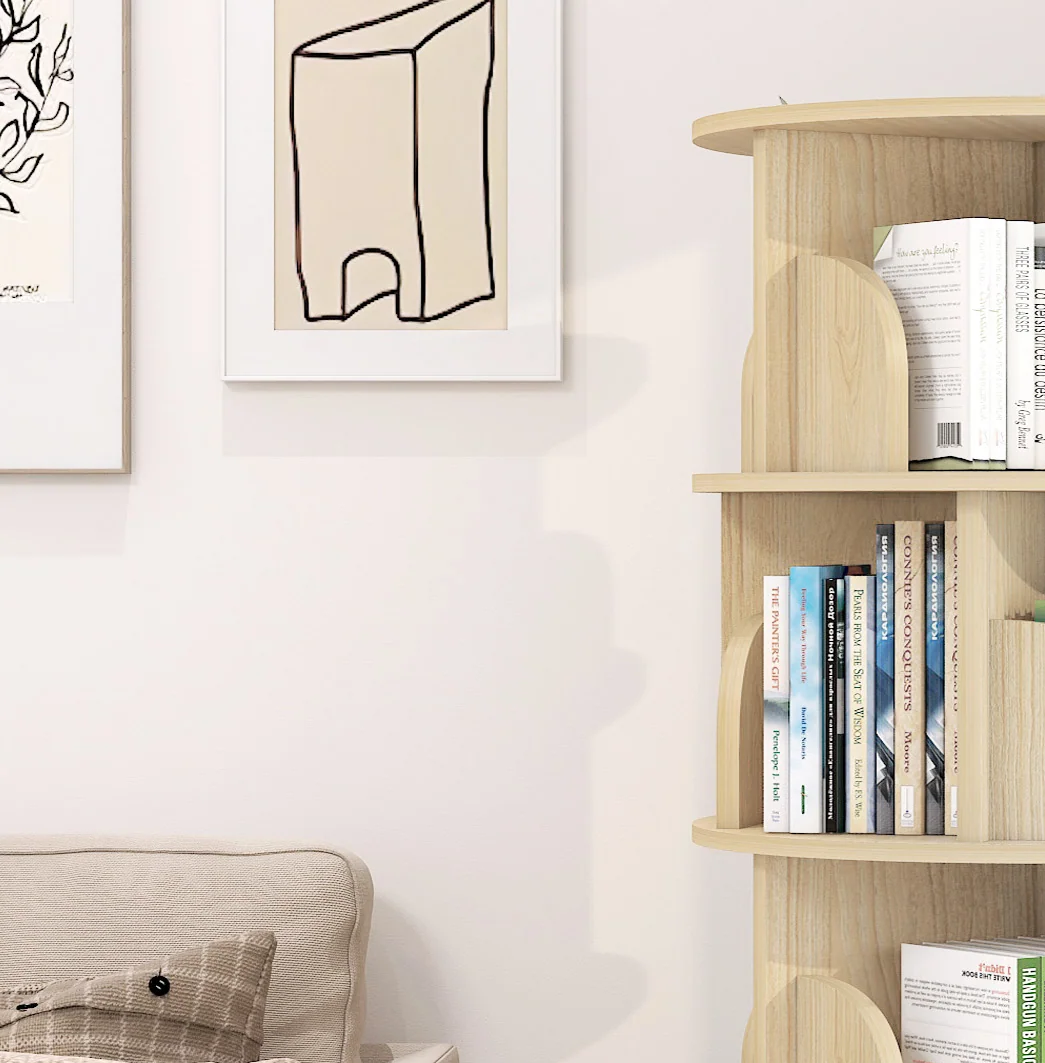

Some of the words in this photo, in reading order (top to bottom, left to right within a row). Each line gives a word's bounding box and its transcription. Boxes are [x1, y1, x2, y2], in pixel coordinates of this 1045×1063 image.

[1016, 247, 1030, 268] THREE
[1016, 271, 1030, 290] PAIRS
[1016, 292, 1030, 301] OF
[1016, 303, 1030, 333] GLASSES
[1017, 400, 1031, 408] by
[1017, 410, 1031, 426] Greg
[1017, 427, 1031, 450] Bennet
[904, 536, 912, 610] CONNIE'S
[771, 587, 781, 606] THE
[827, 587, 835, 621] Дозор
[771, 610, 781, 662] PAINTER'S
[902, 614, 912, 712] CONQUESTS
[771, 666, 781, 691] GIFT
[771, 730, 781, 771] Penelope
[904, 731, 912, 774] Moore
[771, 783, 781, 803] Holt
[1021, 968, 1037, 1028] HANDGUN
